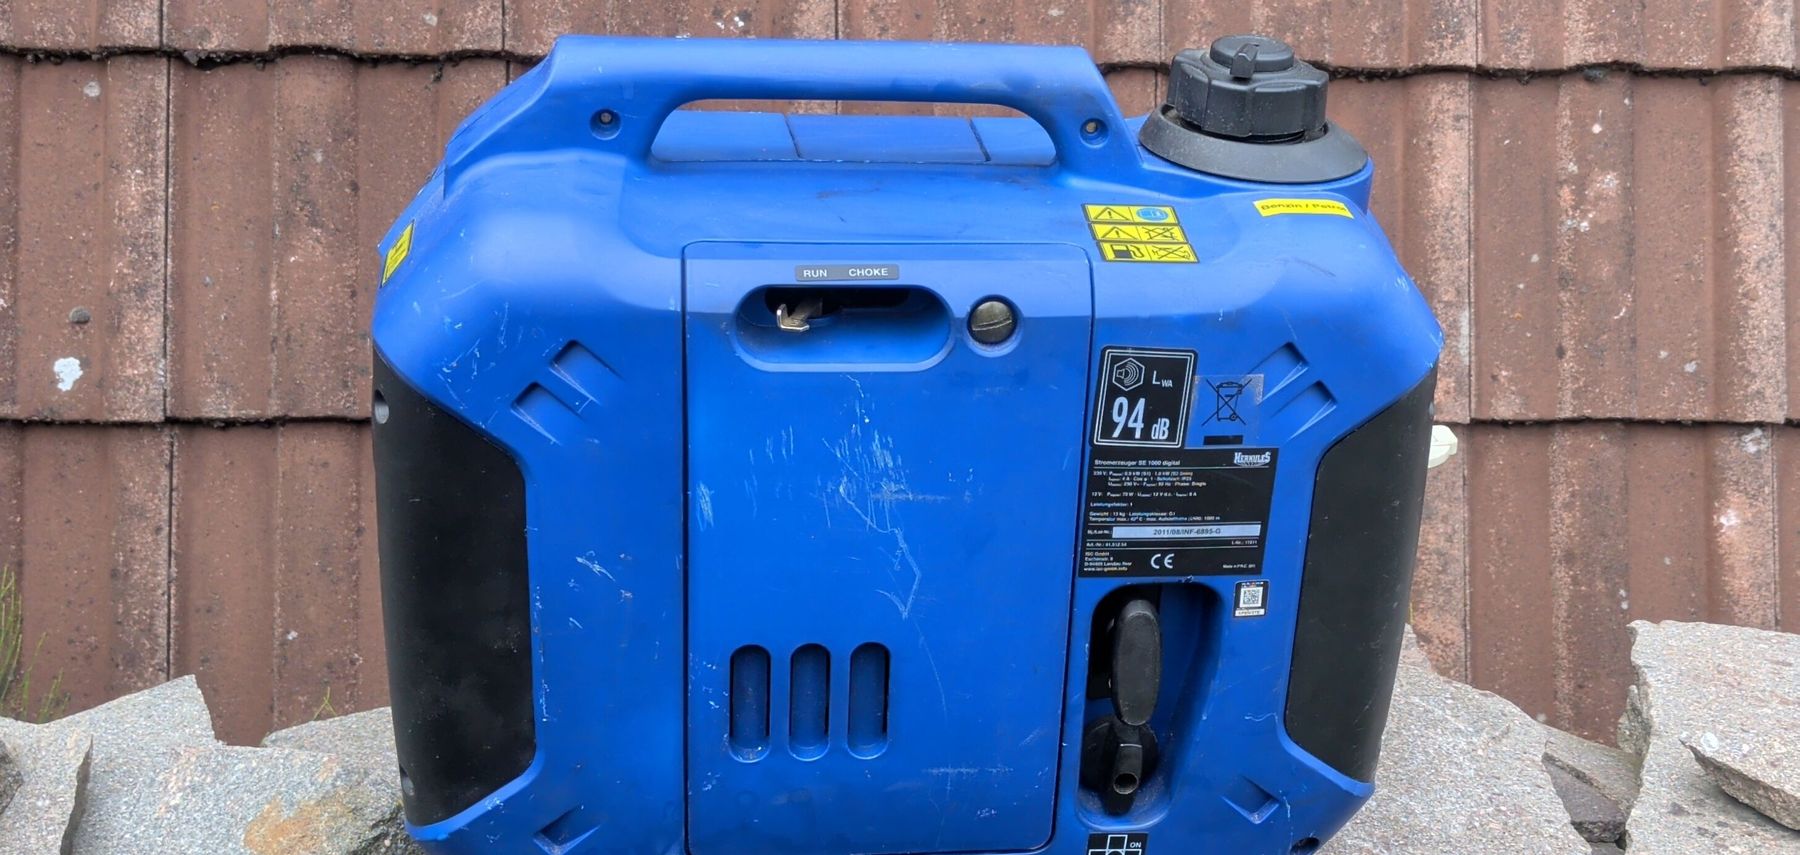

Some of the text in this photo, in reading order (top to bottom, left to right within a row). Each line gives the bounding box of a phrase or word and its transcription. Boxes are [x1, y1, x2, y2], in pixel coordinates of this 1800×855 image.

[803, 267, 889, 278] RUN CHOKE
[1111, 396, 1170, 440] 94 dB
[1094, 459, 1181, 468] Stromerzeuger SE 1000 digital
